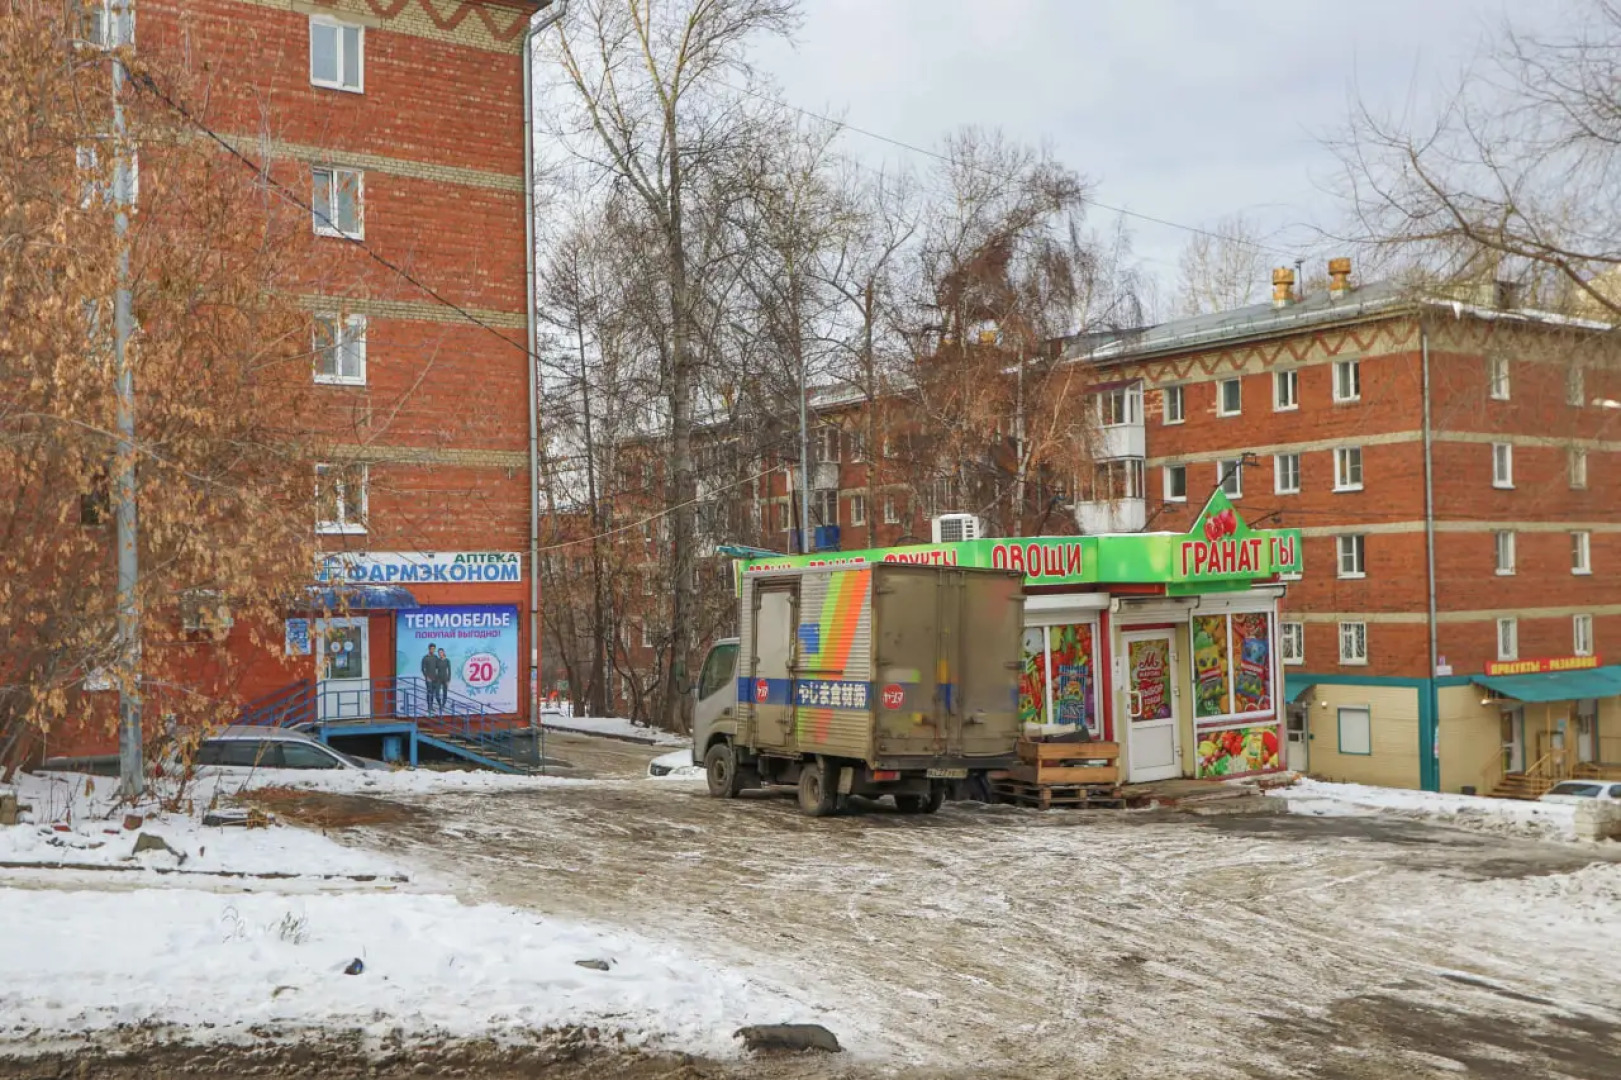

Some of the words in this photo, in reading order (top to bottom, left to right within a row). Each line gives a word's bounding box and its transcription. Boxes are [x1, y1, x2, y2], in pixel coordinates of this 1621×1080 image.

[454, 553, 518, 563] АПТЕКА
[991, 544, 1082, 577] ОВОЩИ
[1182, 539, 1262, 576] ГРАНАТ
[349, 564, 519, 582] ФАРМЭКОНОМ
[405, 612, 510, 629] ТЕРМОБЕЛЬЕ
[415, 630, 456, 639] ПОКУПАЙ
[458, 630, 501, 639] ВЫГОДНО!
